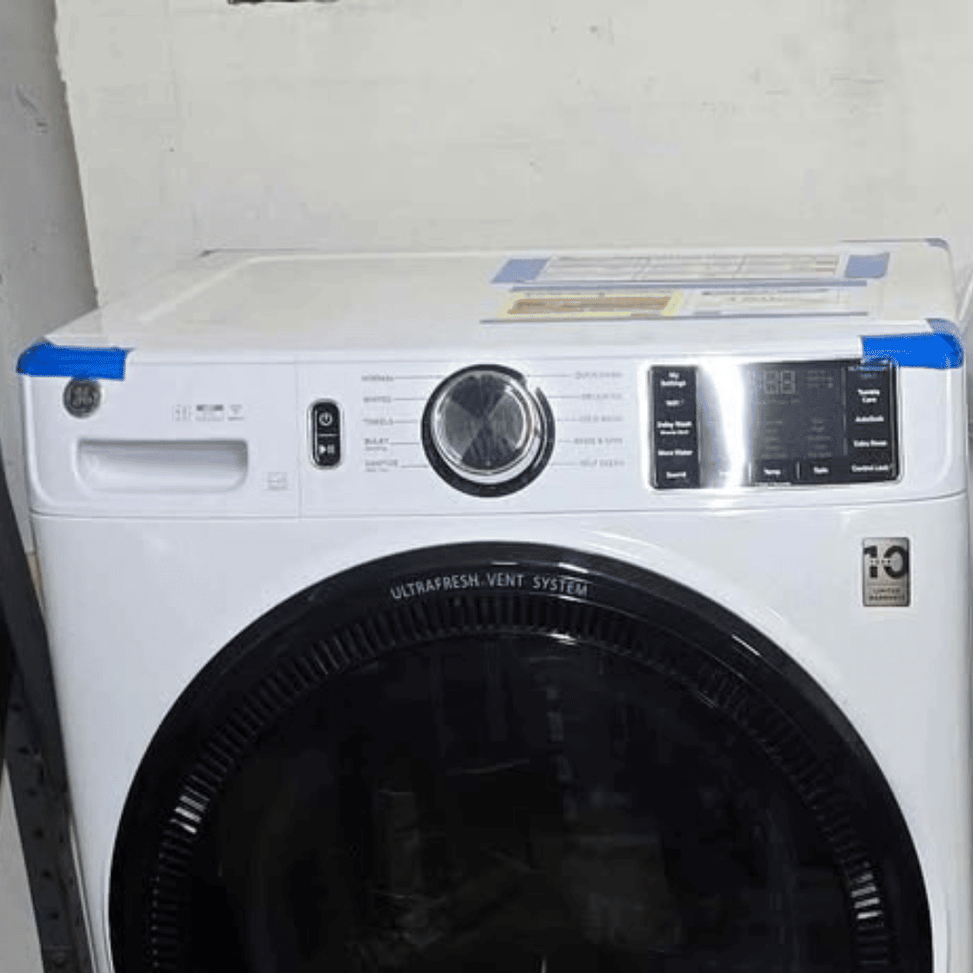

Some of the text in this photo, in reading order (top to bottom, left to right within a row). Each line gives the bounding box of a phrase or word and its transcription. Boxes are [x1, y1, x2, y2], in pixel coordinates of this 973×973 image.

[389, 572, 589, 600] ULTRAFRESH VENT SYSTEM
